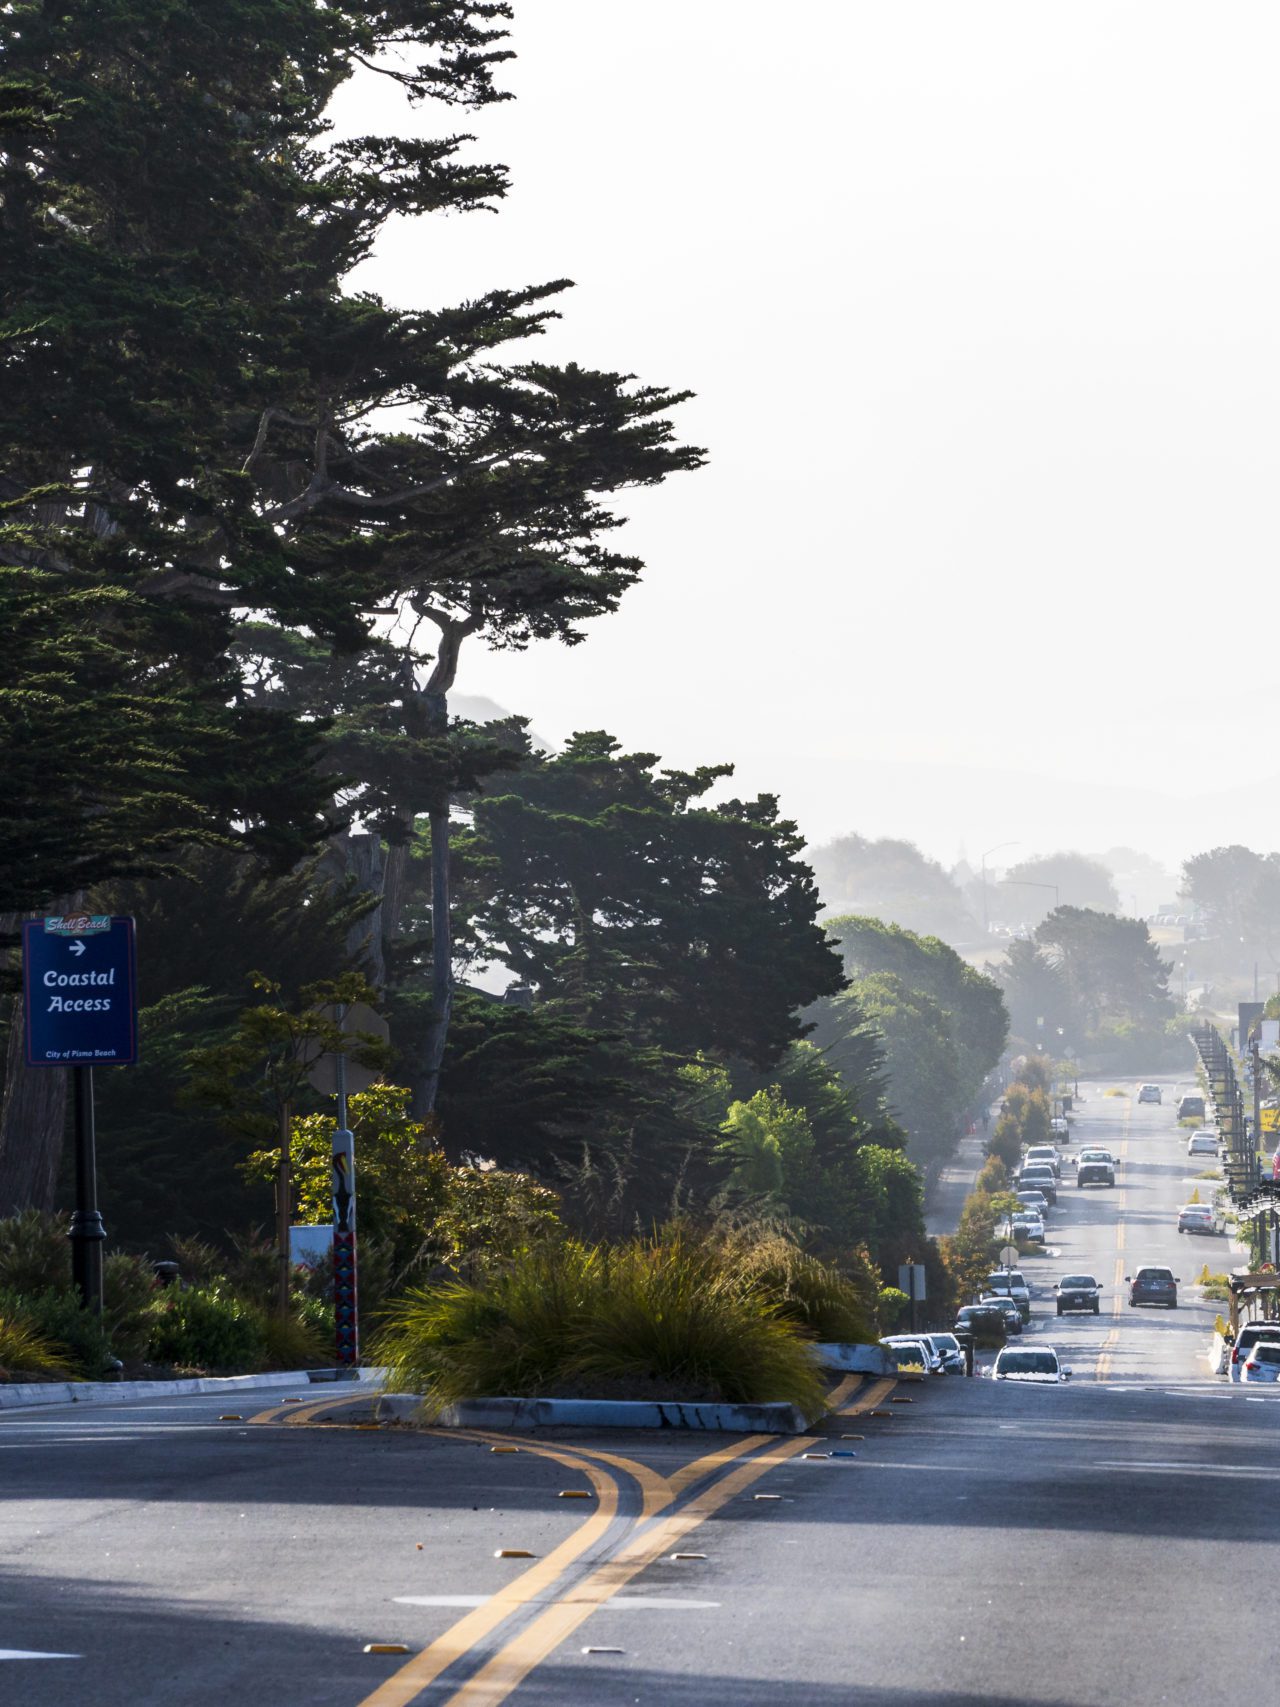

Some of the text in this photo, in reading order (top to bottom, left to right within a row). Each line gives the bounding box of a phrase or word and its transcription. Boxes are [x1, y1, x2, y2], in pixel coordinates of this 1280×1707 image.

[47, 916, 108, 931] Shell Beach
[43, 967, 115, 987] Coastal
[46, 996, 111, 1012] Access
[46, 1048, 116, 1059] City of Pismo Beach
